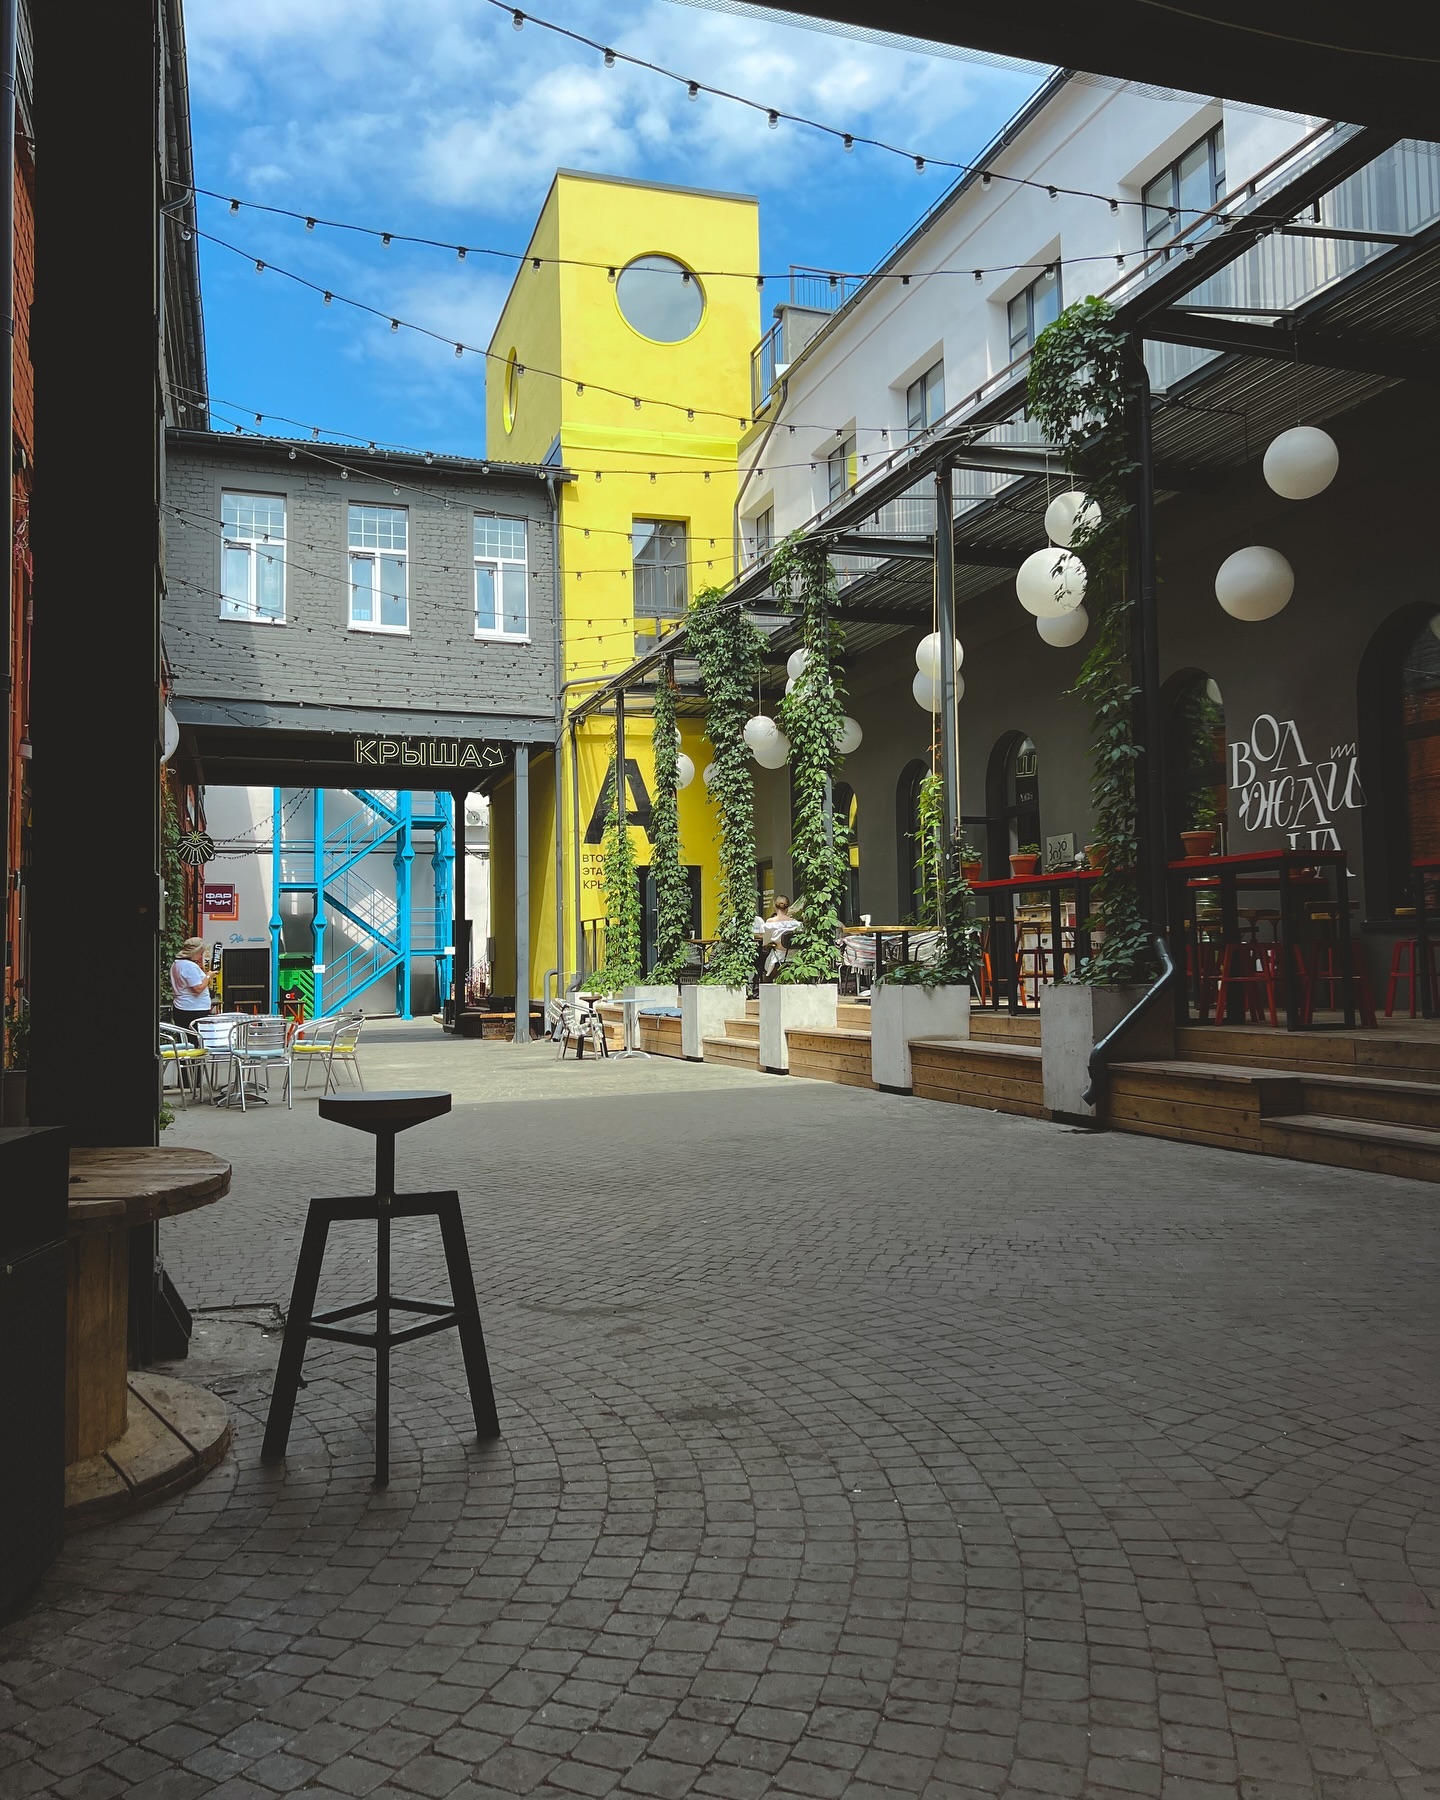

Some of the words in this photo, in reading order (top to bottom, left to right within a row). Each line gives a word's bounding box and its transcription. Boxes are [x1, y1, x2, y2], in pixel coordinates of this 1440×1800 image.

[356, 740, 483, 768] КРЫША
[1228, 713, 1313, 790] ВОЛ
[583, 758, 657, 845] А
[582, 867, 606, 876] ЭТА
